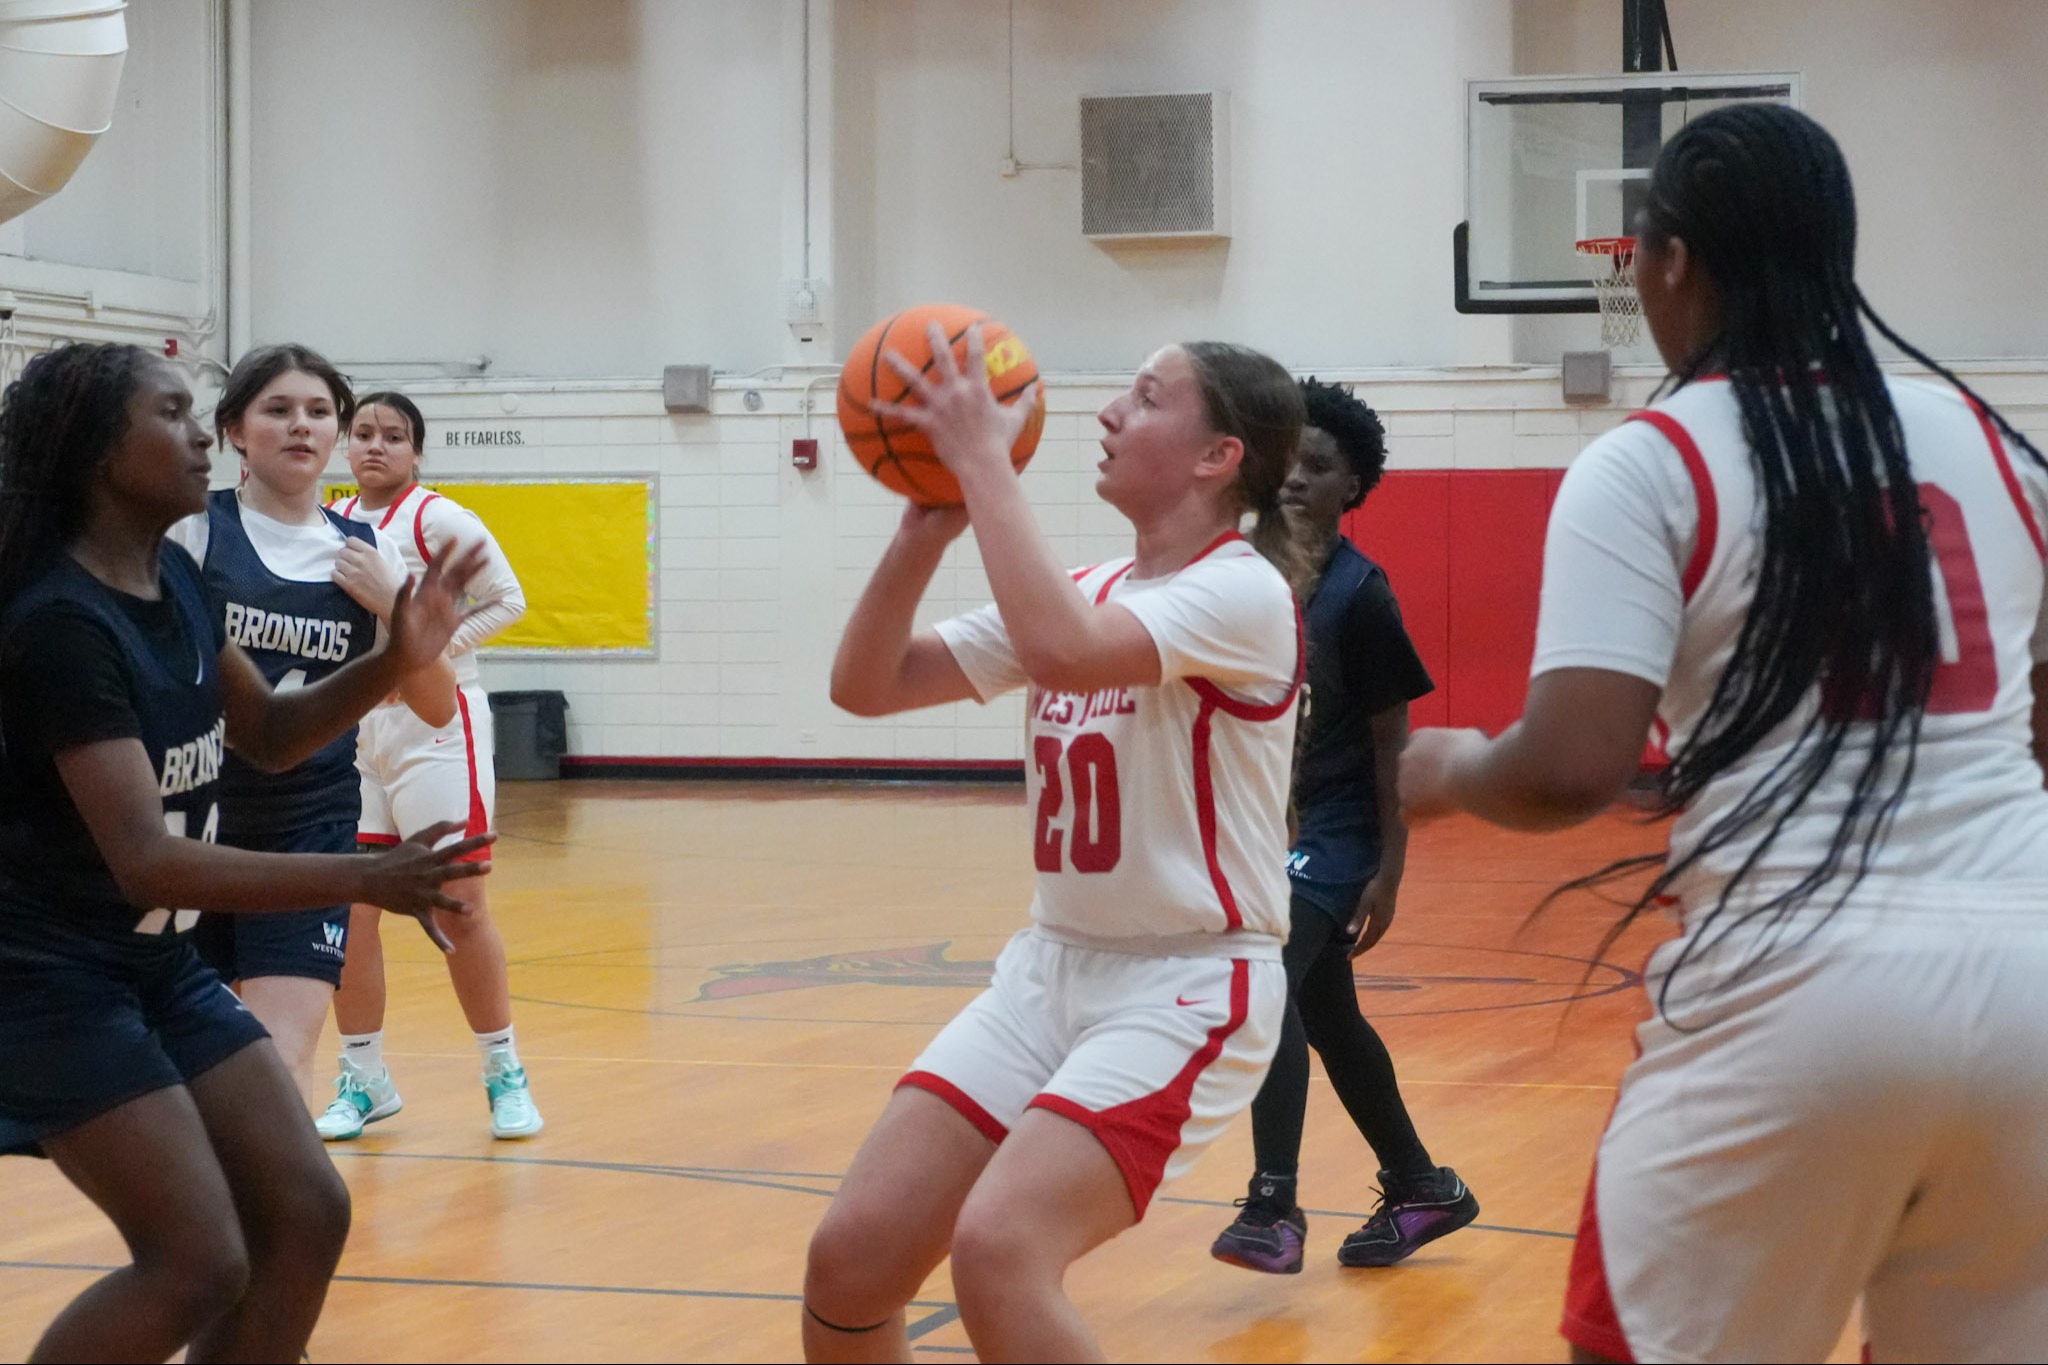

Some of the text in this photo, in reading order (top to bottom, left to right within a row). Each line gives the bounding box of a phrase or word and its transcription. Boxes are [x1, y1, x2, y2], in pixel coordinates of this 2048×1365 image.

[446, 430, 525, 446] BE FEARLESS.
[225, 602, 352, 662] BRONCOS
[1034, 732, 1121, 874] 20
